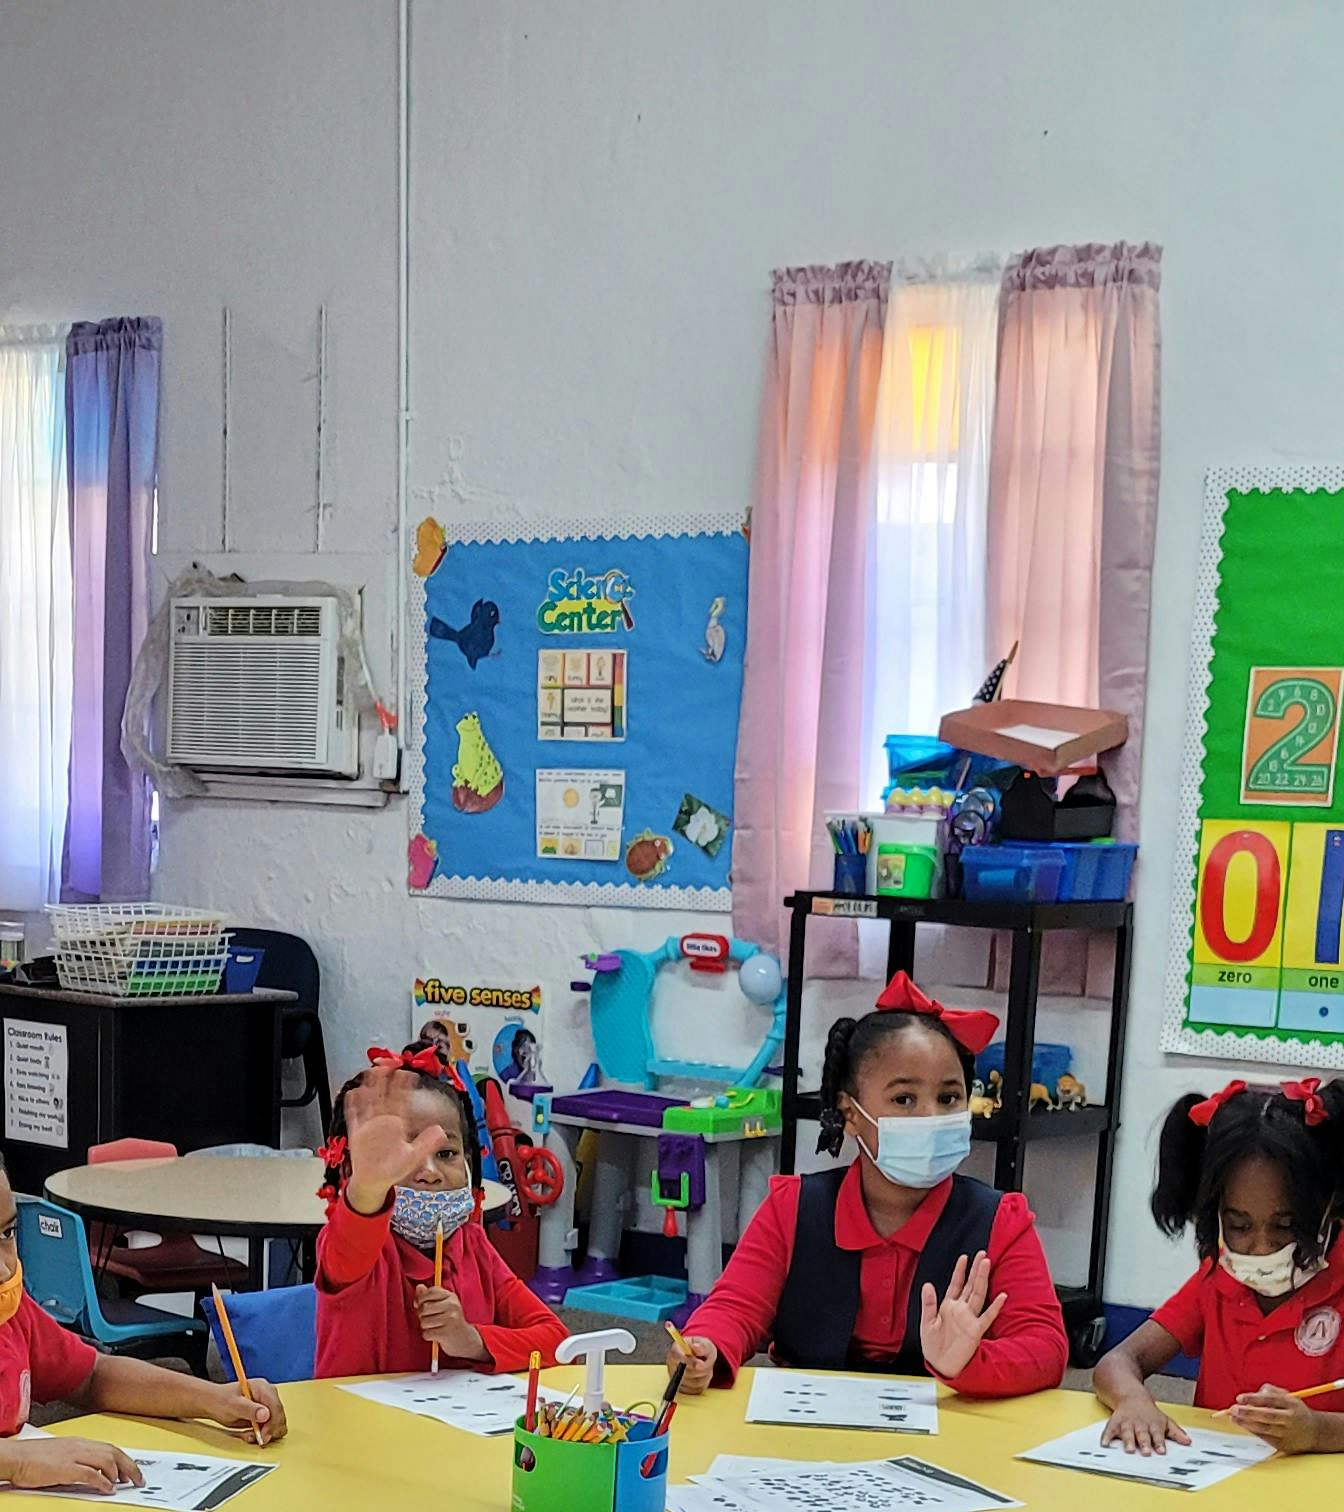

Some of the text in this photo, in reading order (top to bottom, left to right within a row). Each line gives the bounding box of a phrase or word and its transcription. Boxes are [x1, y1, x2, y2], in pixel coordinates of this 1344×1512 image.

[537, 600, 622, 632] Center
[1244, 677, 1336, 793] 2
[1200, 830, 1281, 963] 0
[424, 979, 532, 1010] five senses
[1218, 970, 1252, 984] zero
[1308, 974, 1339, 989] one
